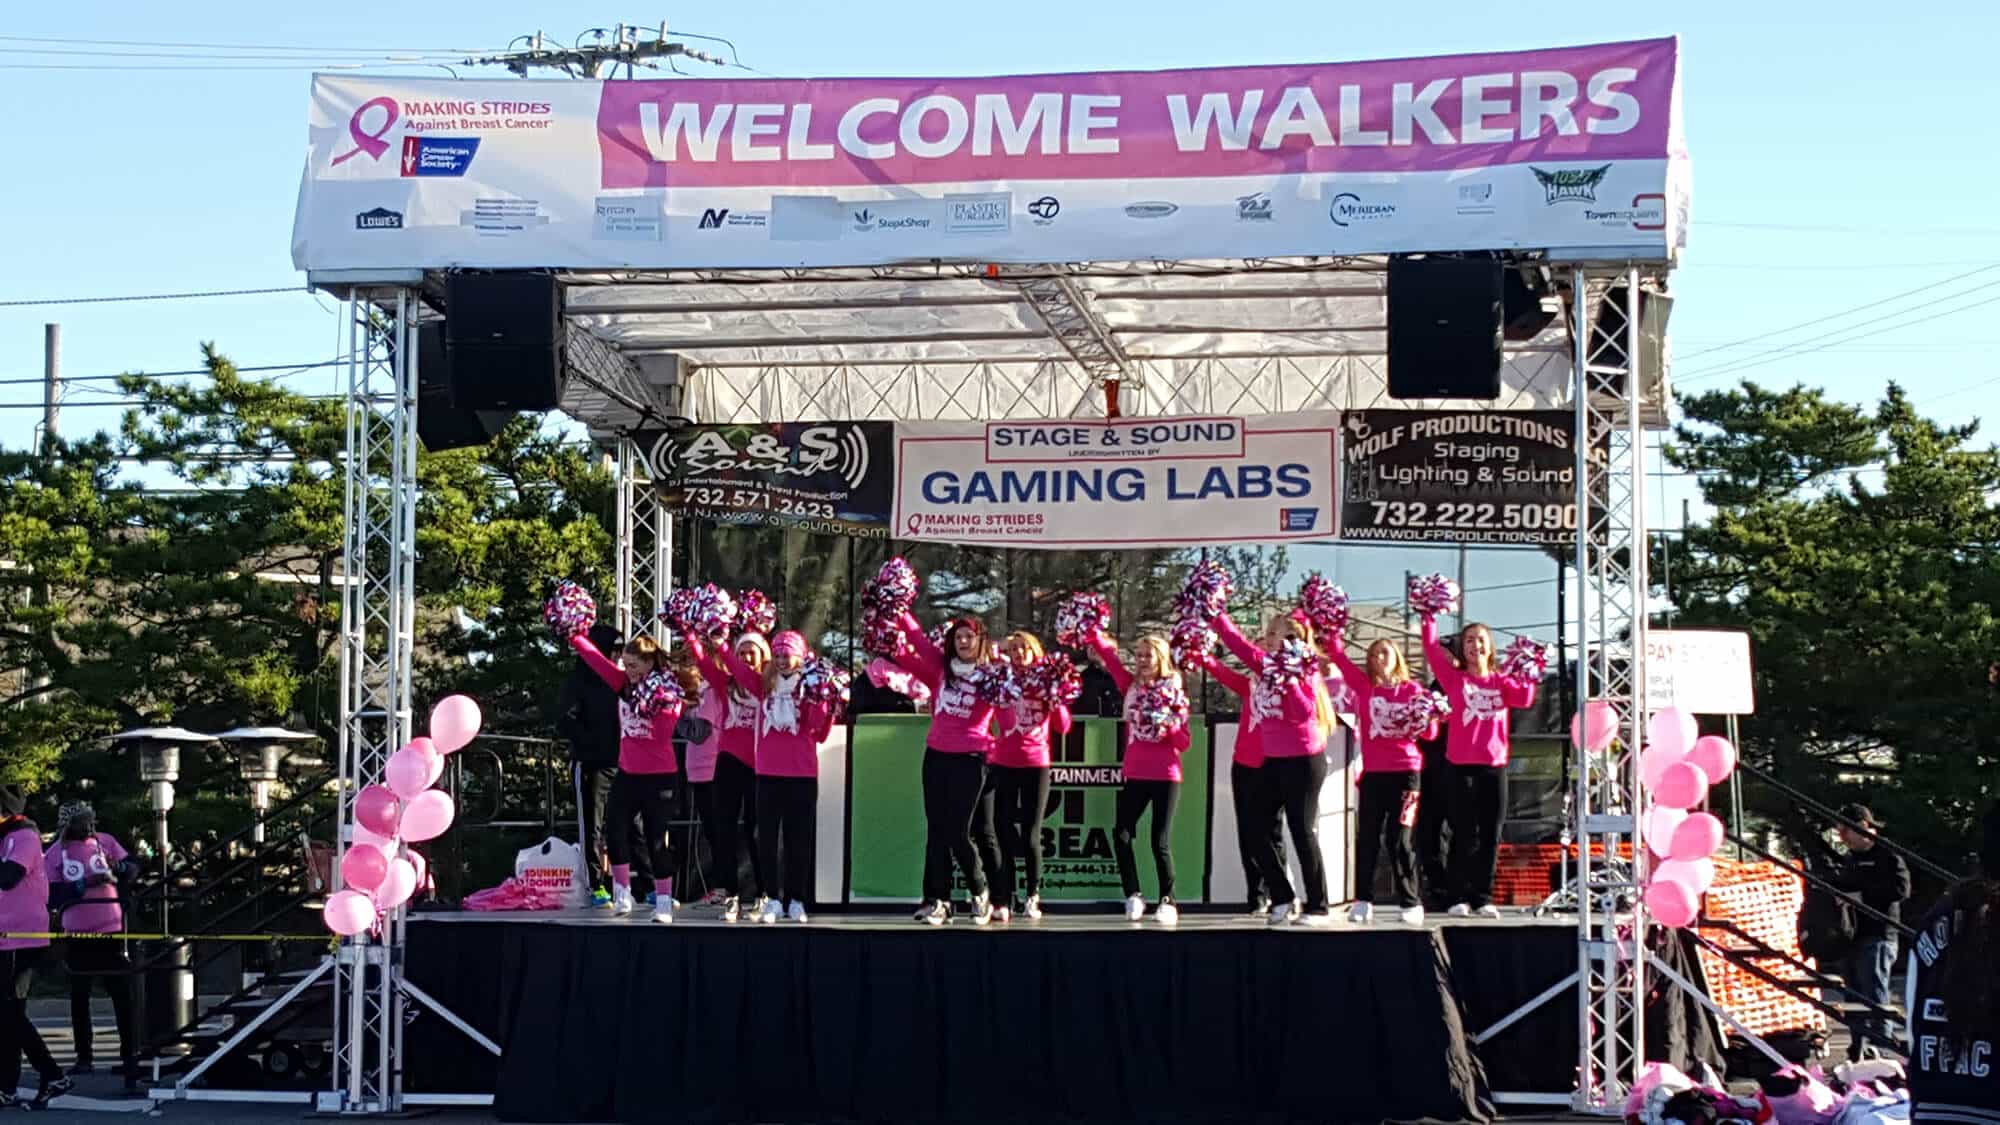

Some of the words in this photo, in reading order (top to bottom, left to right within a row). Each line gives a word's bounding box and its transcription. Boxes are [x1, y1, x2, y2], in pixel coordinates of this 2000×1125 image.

[404, 102, 475, 116] MAKING
[481, 101, 551, 115] STRIDES
[639, 92, 1121, 161] WELCOME
[1166, 67, 1640, 151] WALKERS
[405, 119, 456, 132] Against
[461, 119, 500, 129] Breast
[505, 119, 549, 129] Cancer
[422, 146, 469, 156] American
[1547, 184, 1596, 201] HAWK
[1339, 204, 1395, 217] MERIDIAN
[994, 428, 1090, 448] STAGE
[1101, 428, 1121, 447] &
[1131, 422, 1236, 445] SOUND
[1348, 426, 1404, 464] WOLF
[1411, 415, 1569, 449] PRODUCTIONS
[1434, 442, 1520, 462] Staging
[687, 449, 839, 477] Sound
[922, 467, 1146, 505] GAMING
[1167, 463, 1312, 501] LABS
[1380, 464, 1469, 485] Lighting
[1477, 467, 1493, 482] &
[1502, 466, 1573, 483] Sound
[684, 477, 754, 489] Entertainment
[766, 482, 792, 495] Event
[795, 489, 848, 501] Production
[683, 487, 835, 520] 732.571.2623
[925, 514, 981, 526] MAKING
[985, 513, 1043, 526] STRIDES
[1371, 501, 1578, 529] 732.222.5090
[925, 526, 965, 536] Against
[968, 526, 1003, 535] Breast
[1006, 526, 1044, 535] Cancer
[1344, 527, 1606, 544] WWW.WOLFPRODUCTIONSLLC.CM
[1049, 767, 1128, 784] TAINMEN
